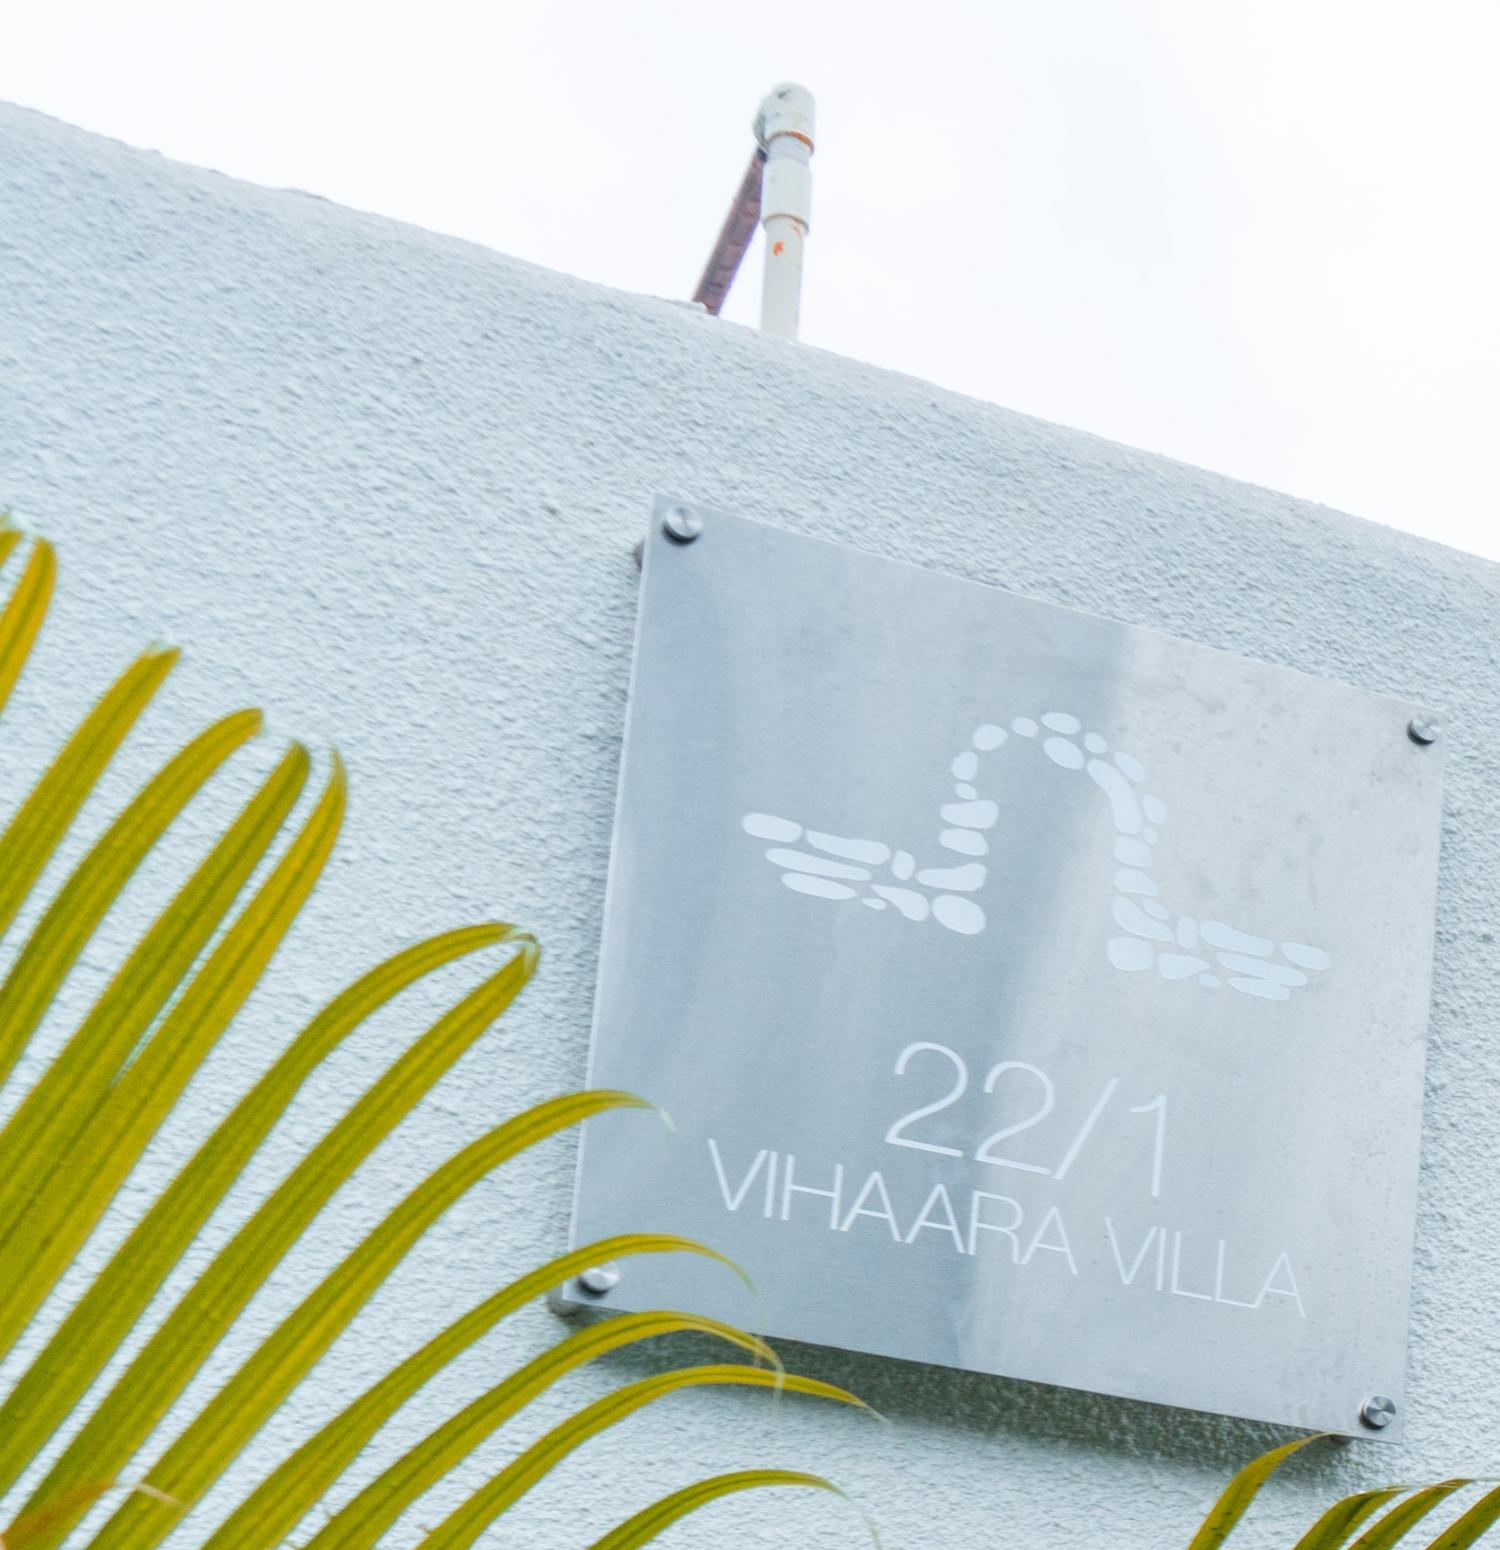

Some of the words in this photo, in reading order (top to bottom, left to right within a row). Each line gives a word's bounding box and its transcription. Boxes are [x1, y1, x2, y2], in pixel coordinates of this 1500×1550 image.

[884, 1041, 1171, 1197] 22/1
[707, 1137, 1078, 1276] VIHAARA
[1105, 1216, 1307, 1318] VILLA
